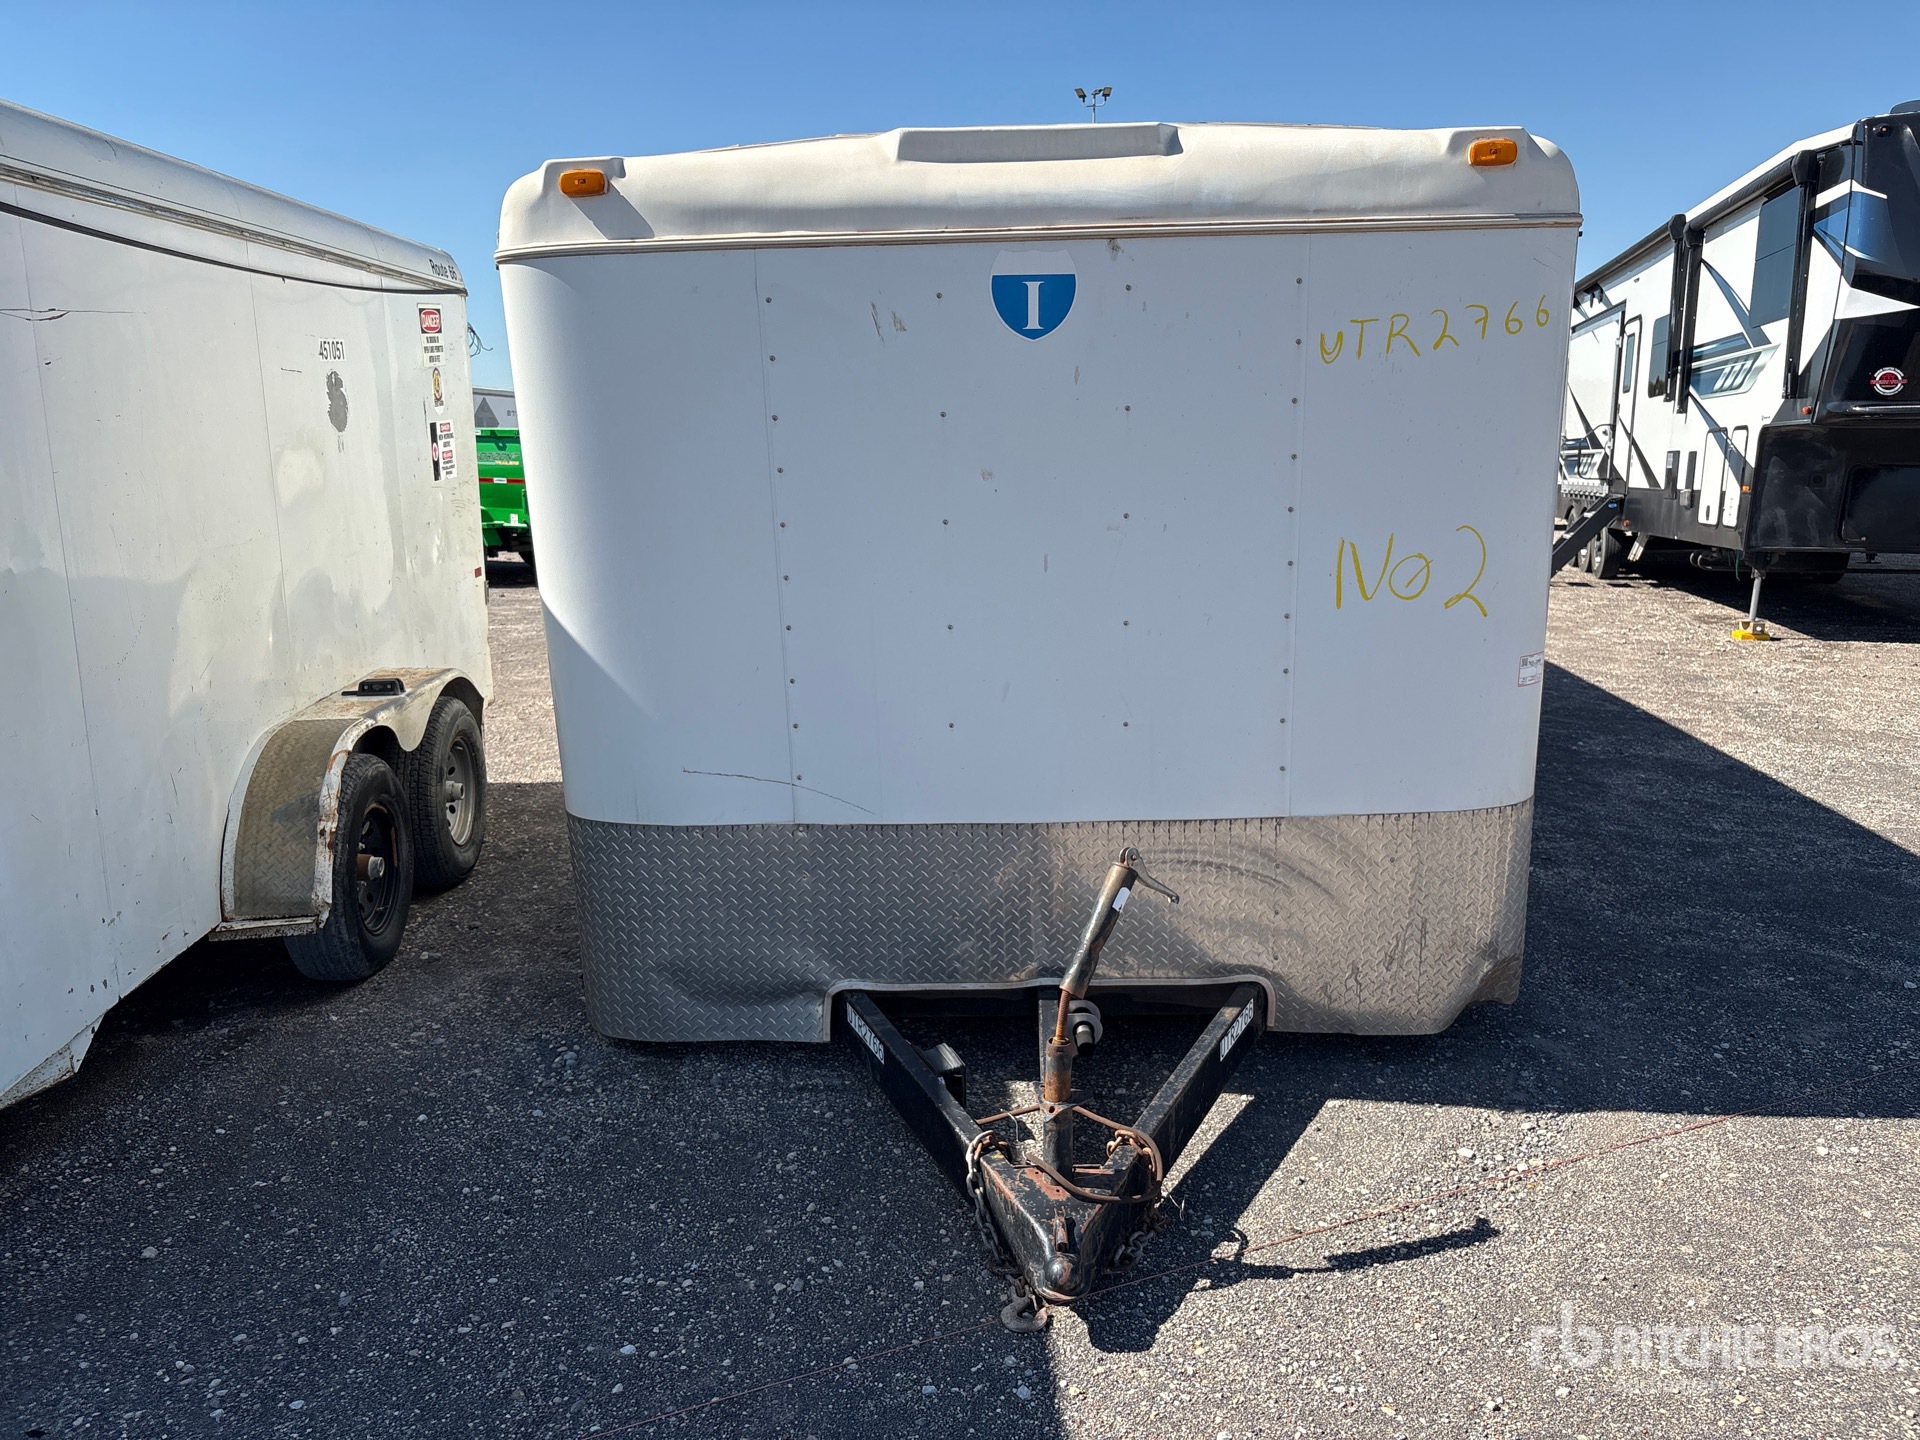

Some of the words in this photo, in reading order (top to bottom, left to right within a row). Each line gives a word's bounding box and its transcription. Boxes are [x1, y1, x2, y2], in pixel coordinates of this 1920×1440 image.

[429, 259, 449, 279] Route
[448, 265, 458, 281] 66
[1022, 281, 1044, 330] I
[318, 341, 345, 360] 451051
[847, 1006, 884, 1062] UTR2766
[1220, 1000, 1253, 1060] UTR2766
